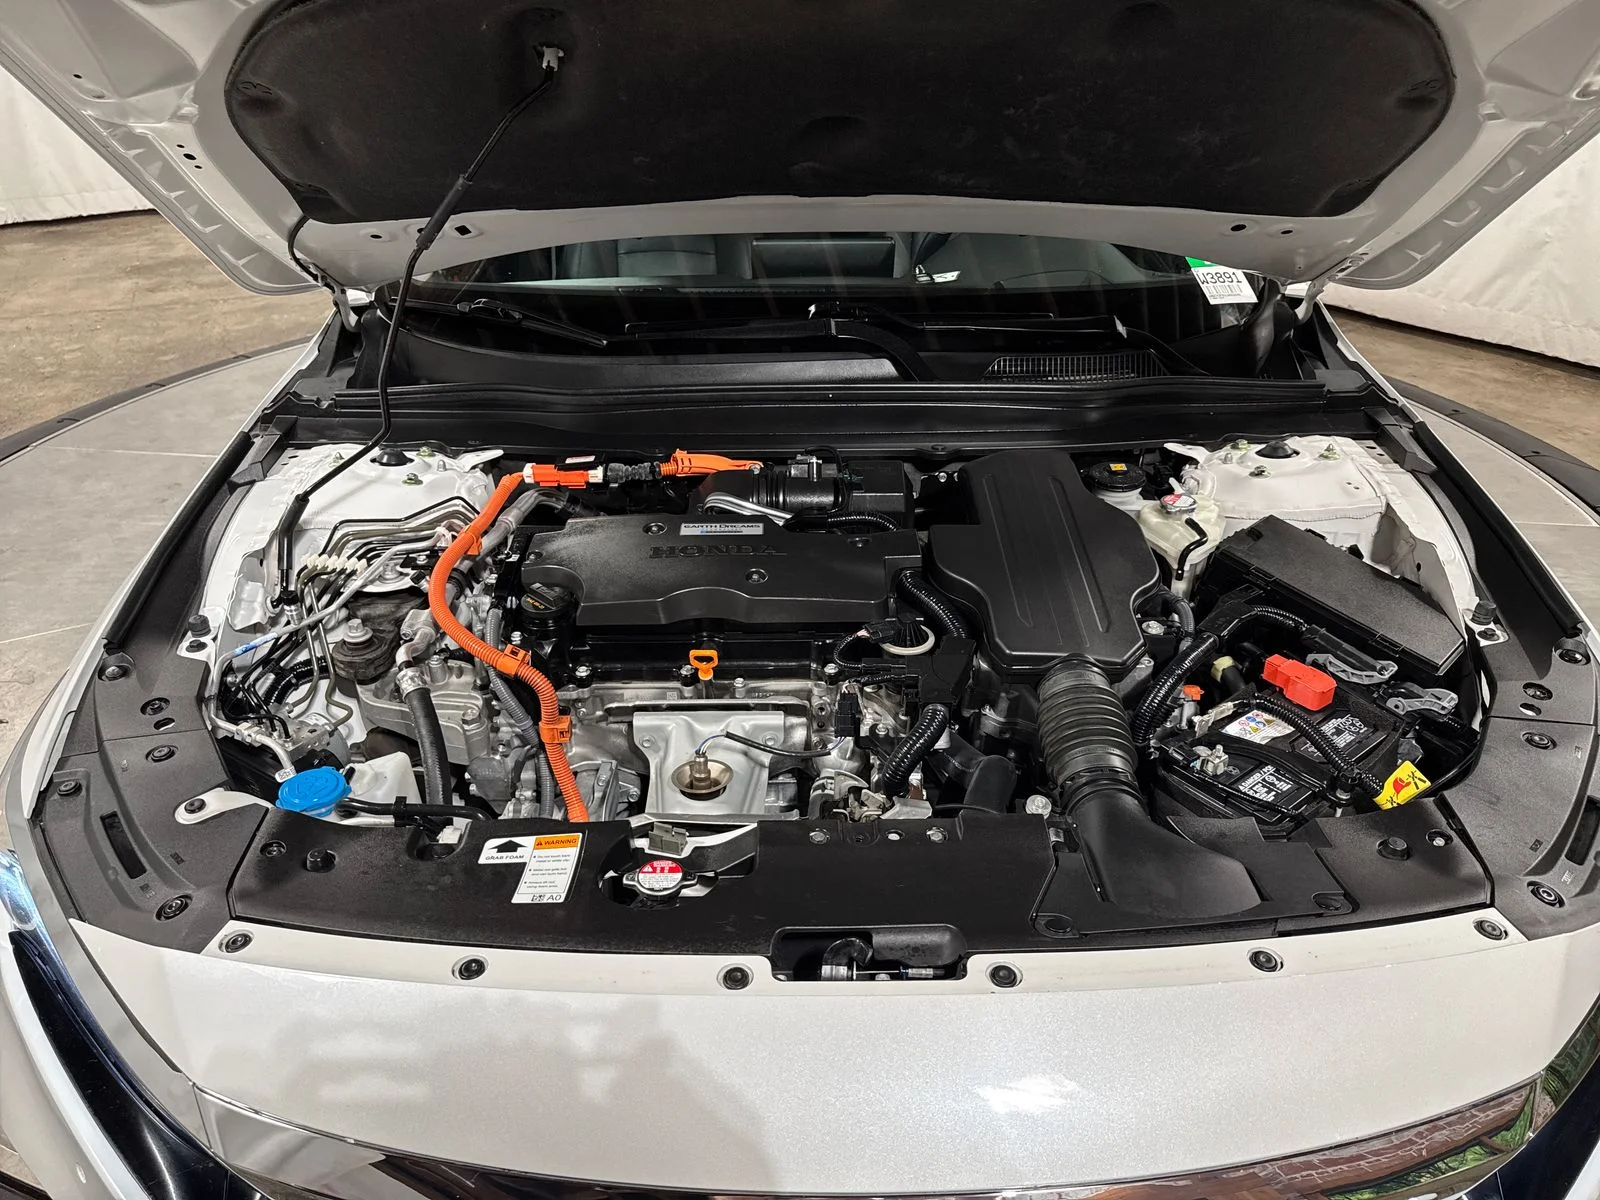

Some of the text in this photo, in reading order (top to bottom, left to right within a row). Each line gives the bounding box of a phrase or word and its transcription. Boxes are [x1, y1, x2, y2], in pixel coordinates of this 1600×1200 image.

[1196, 271, 1242, 285] W3891
[649, 544, 788, 559] HONDA
[544, 838, 577, 846] WARNING
